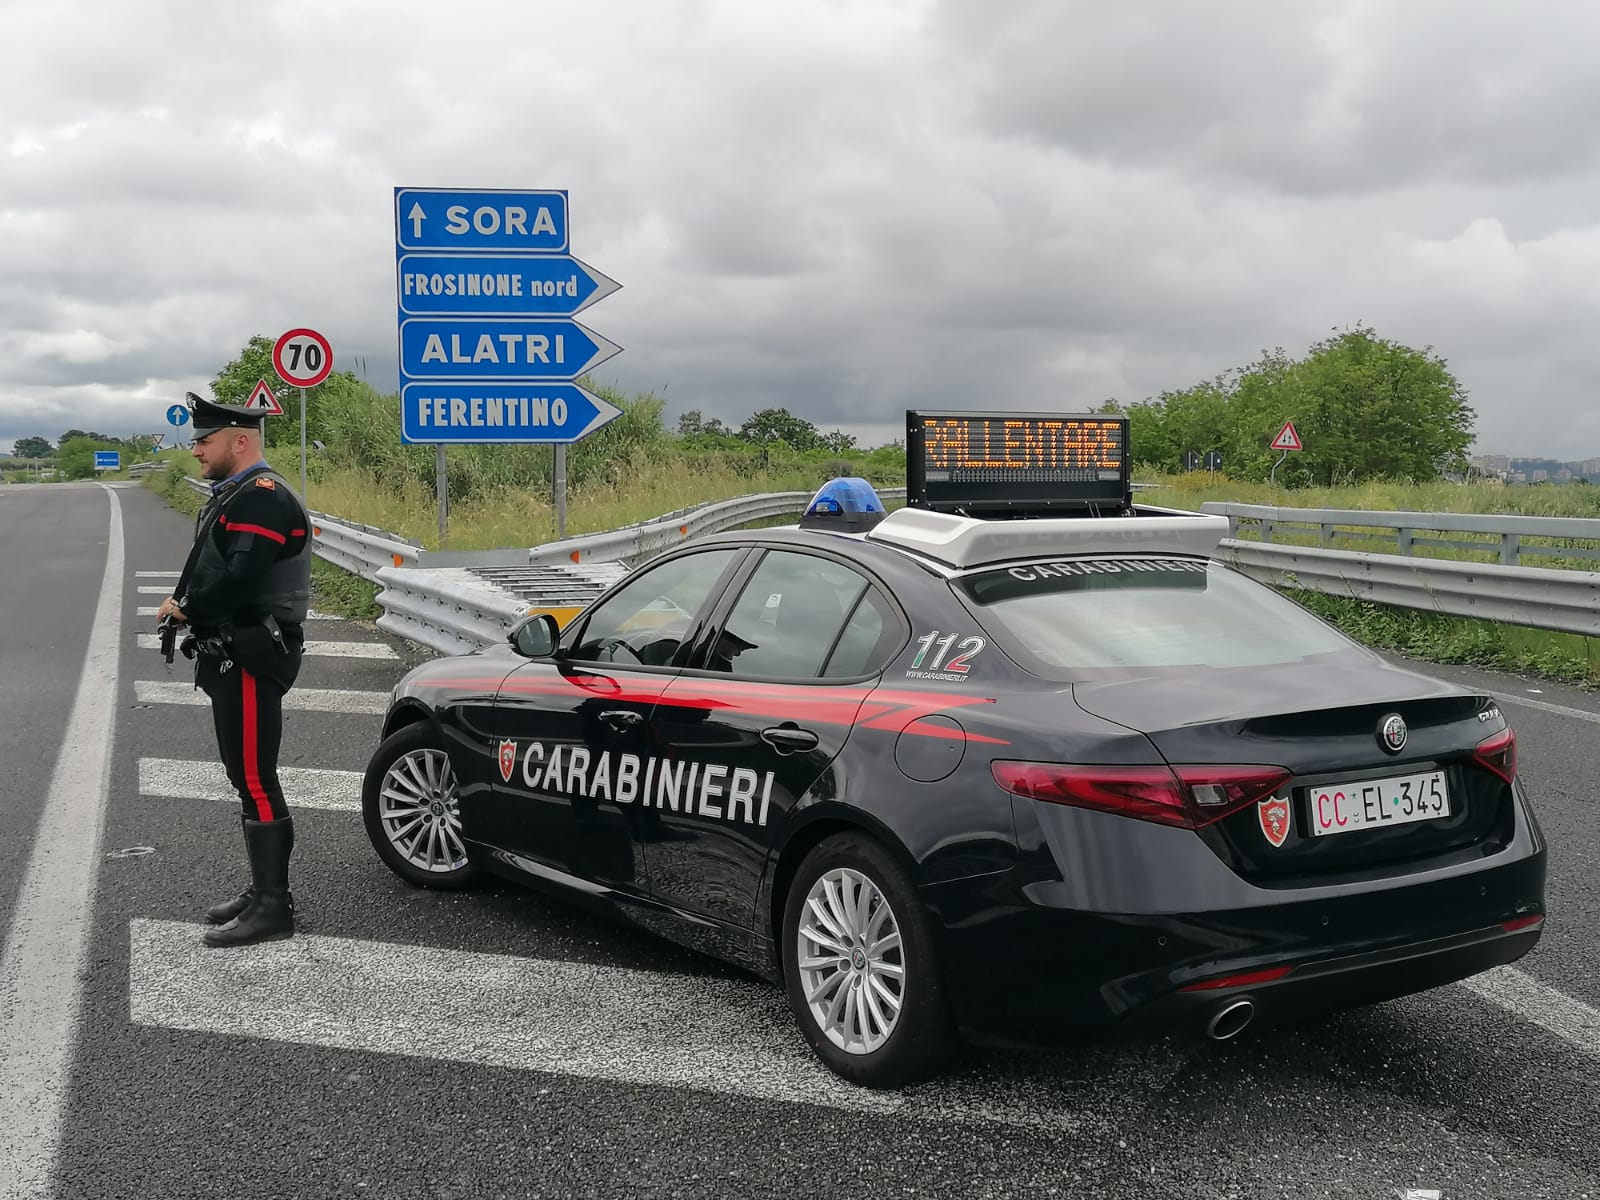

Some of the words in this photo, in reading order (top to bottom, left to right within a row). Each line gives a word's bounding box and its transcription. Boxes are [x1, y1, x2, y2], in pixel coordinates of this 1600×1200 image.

[444, 205, 558, 236] SORA
[403, 273, 523, 297] FROSINONE
[531, 274, 578, 297] nord
[288, 344, 322, 371] 70
[420, 334, 565, 364] ALATRI
[418, 397, 569, 427] FERENTINO
[923, 419, 1121, 469] RALLENTARE
[911, 630, 986, 673] 112
[522, 741, 775, 827] CARABINIERI
[1317, 791, 1348, 829] CC
[1362, 786, 1392, 823] EL
[1399, 778, 1443, 817] 345
